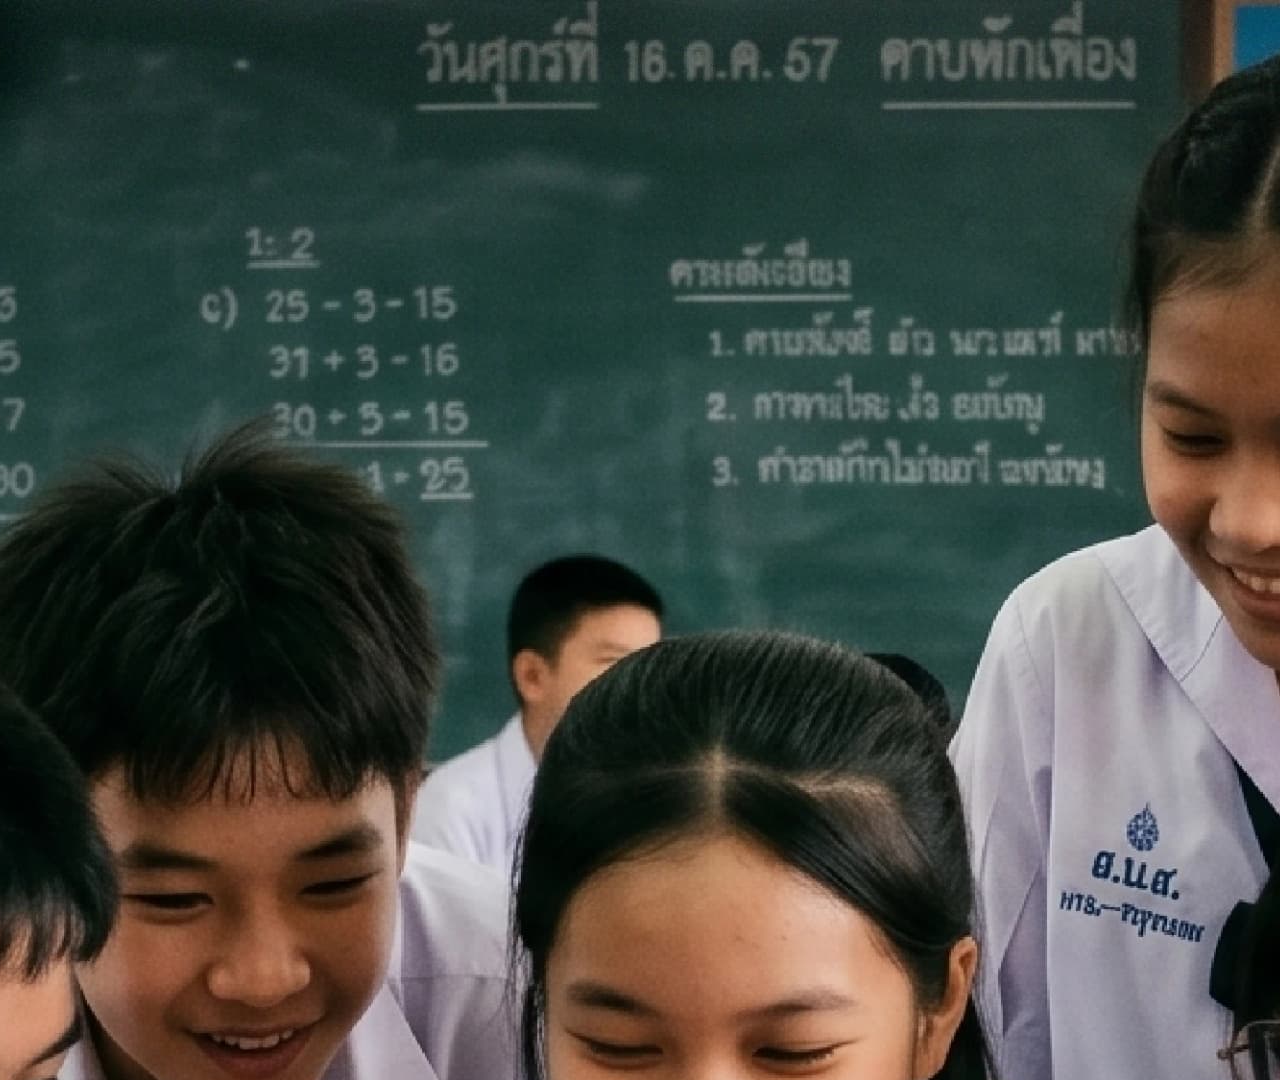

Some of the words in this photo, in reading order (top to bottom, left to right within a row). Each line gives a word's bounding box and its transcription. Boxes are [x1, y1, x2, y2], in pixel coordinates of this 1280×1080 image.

[285, 227, 315, 261] 2
[266, 289, 309, 323] 25
[354, 288, 377, 323] 3
[414, 285, 457, 320] 15
[269, 344, 310, 379] 31
[356, 344, 379, 380] 3
[421, 342, 460, 377] 16
[424, 401, 469, 436] 15
